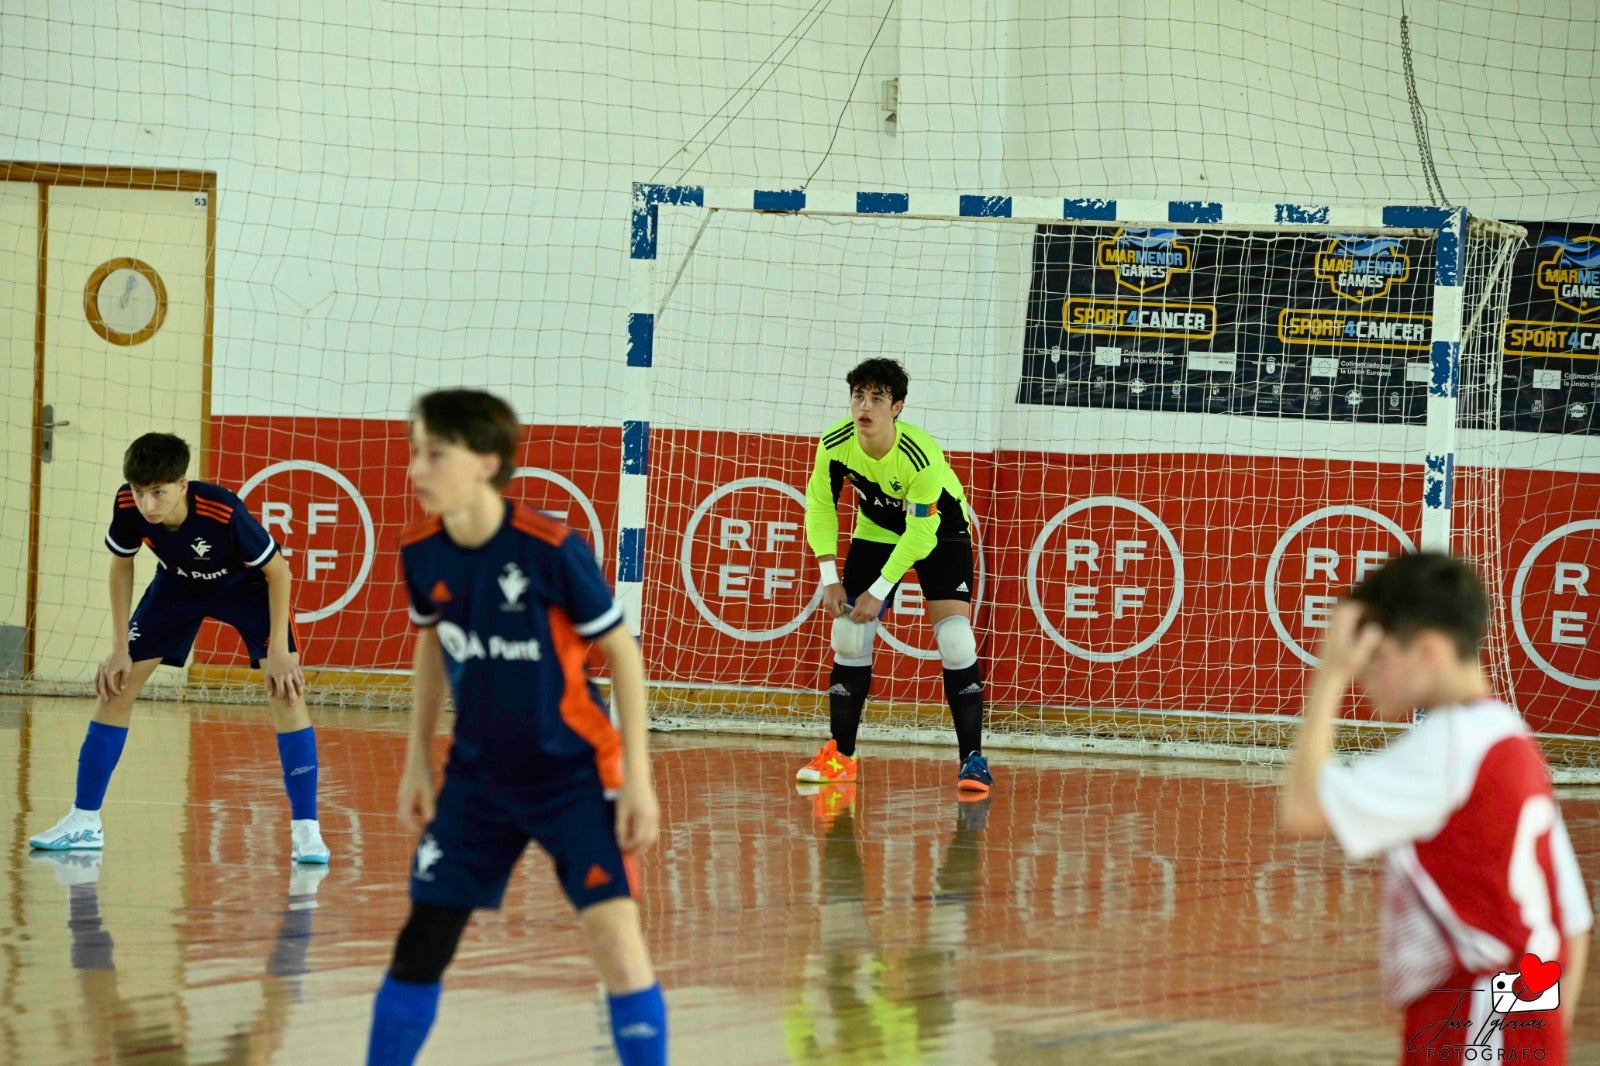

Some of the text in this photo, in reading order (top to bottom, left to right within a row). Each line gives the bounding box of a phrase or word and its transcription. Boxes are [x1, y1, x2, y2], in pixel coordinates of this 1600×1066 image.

[195, 198, 207, 207] 53
[1105, 249, 1183, 266] MARMENOR
[1121, 263, 1166, 278] GAMES
[1322, 258, 1402, 275] MARMENOR
[1338, 273, 1384, 288] GAMES
[1073, 307, 1206, 329] SPORT4CANCER
[1289, 317, 1425, 341] SPORT4CANCER
